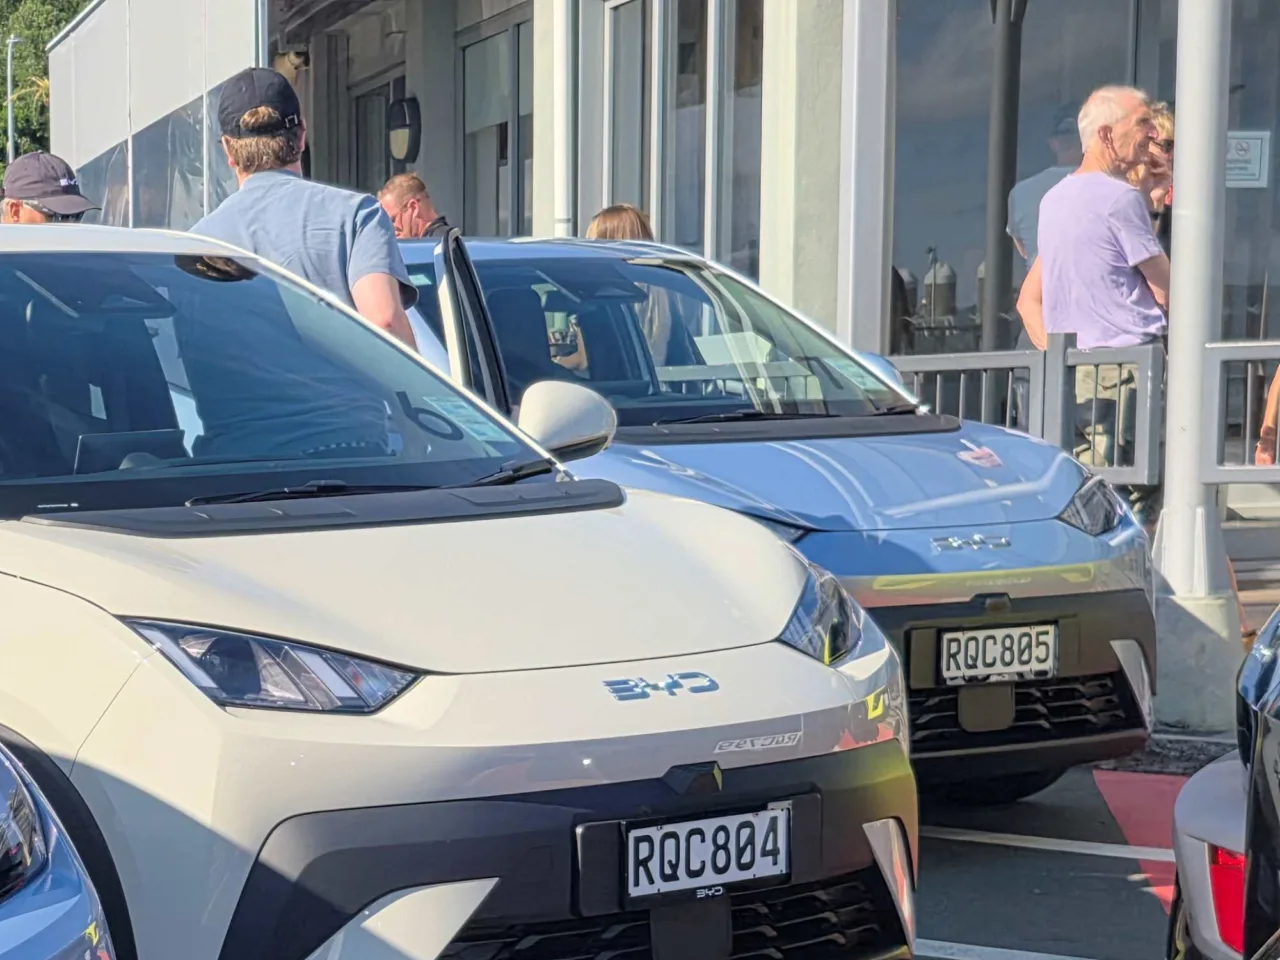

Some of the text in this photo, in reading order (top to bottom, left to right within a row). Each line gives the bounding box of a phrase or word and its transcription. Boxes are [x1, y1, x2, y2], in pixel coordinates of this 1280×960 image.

[945, 630, 1050, 672] RQC805
[602, 671, 719, 701] BYD
[632, 815, 781, 888] RQC804
[696, 886, 724, 898] BYD
